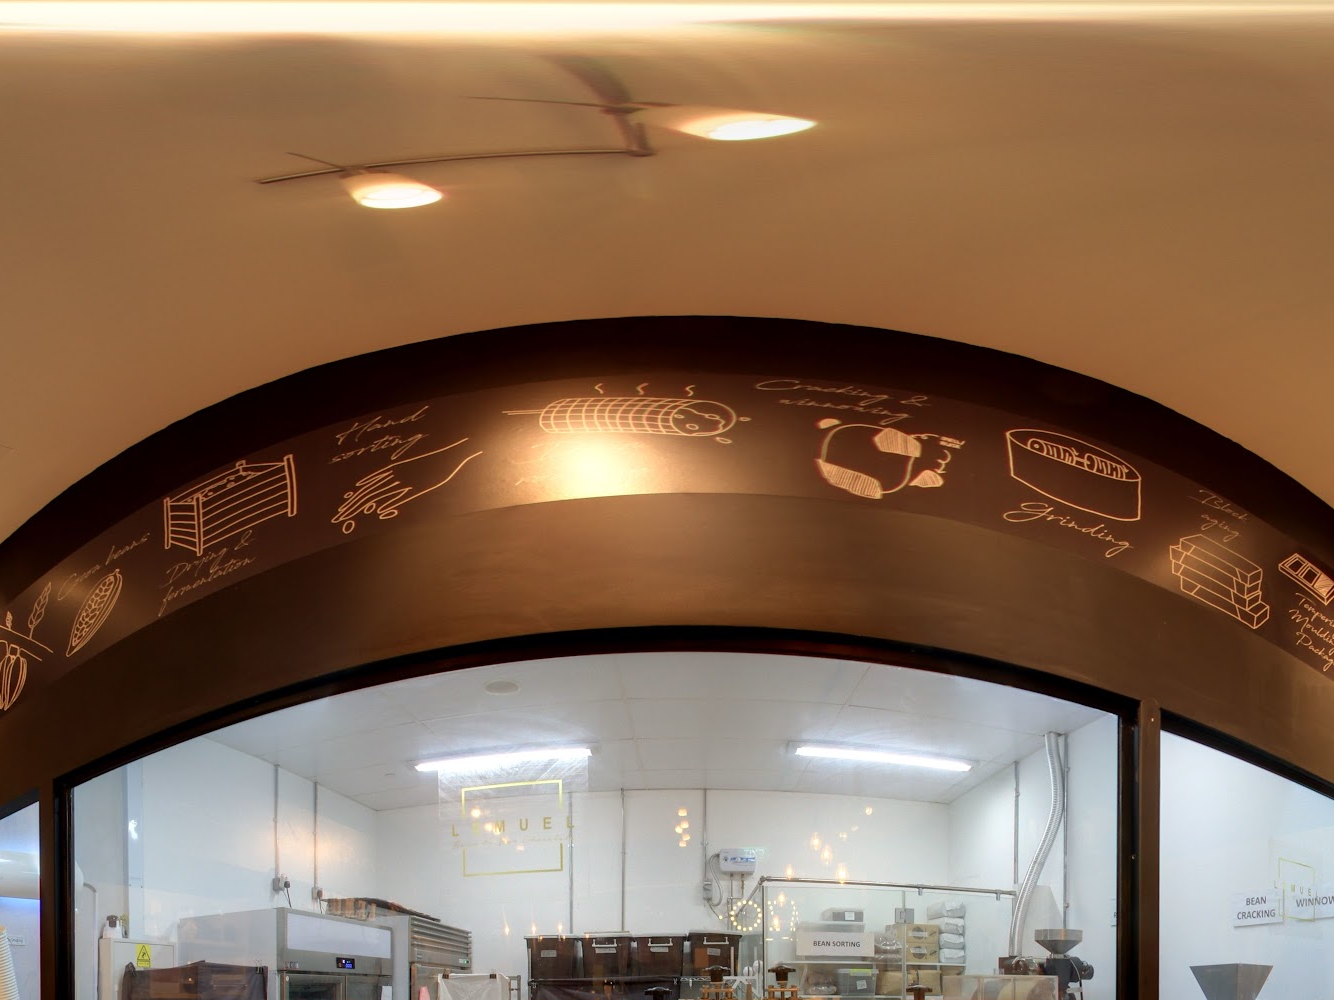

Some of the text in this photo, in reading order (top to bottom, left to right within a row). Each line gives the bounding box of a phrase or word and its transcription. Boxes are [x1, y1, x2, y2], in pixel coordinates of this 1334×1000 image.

[754, 379, 893, 407] Cracking
[336, 405, 430, 445] Hand
[327, 433, 430, 465] sorting
[1003, 501, 1135, 558] Grinding
[162, 546, 227, 588] Drying
[1236, 909, 1276, 920] CRACKING
[1245, 895, 1267, 906] BEAN
[812, 939, 861, 949] BEAN SORTING
